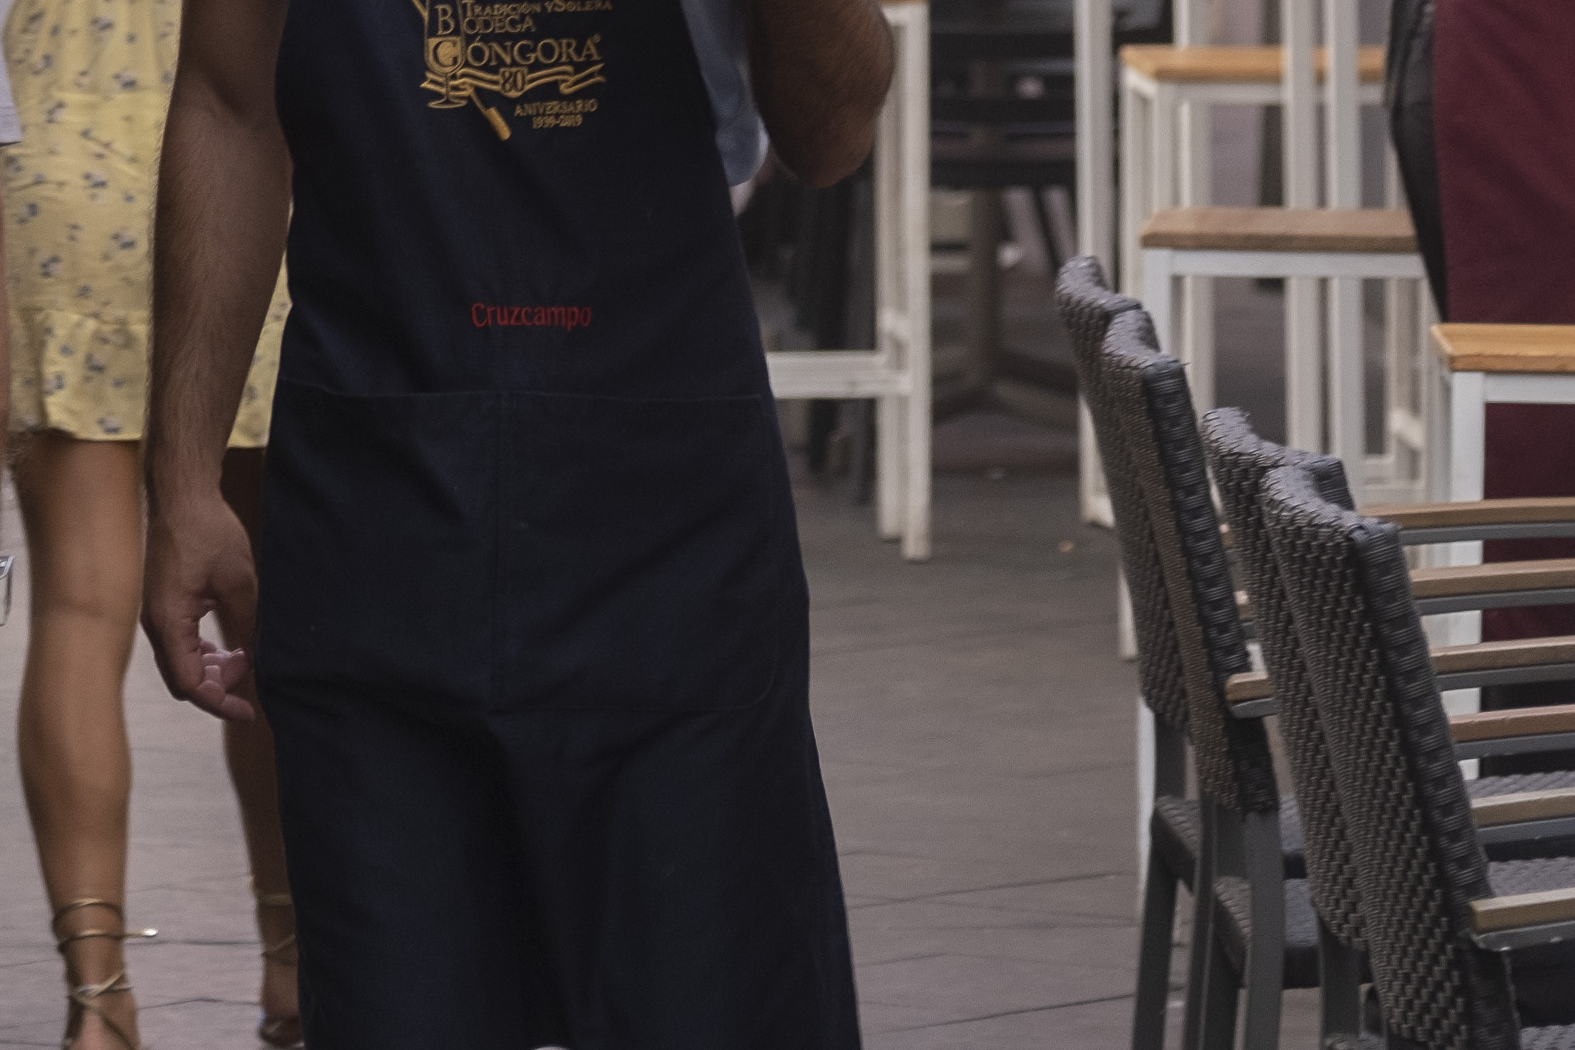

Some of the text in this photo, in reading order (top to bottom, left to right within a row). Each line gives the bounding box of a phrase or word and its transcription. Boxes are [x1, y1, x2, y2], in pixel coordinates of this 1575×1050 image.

[434, 3, 537, 35] BODEGA
[501, 69, 526, 93] 80
[514, 99, 598, 117] ANIVERSARIO
[471, 302, 593, 332] Cruzcampo
